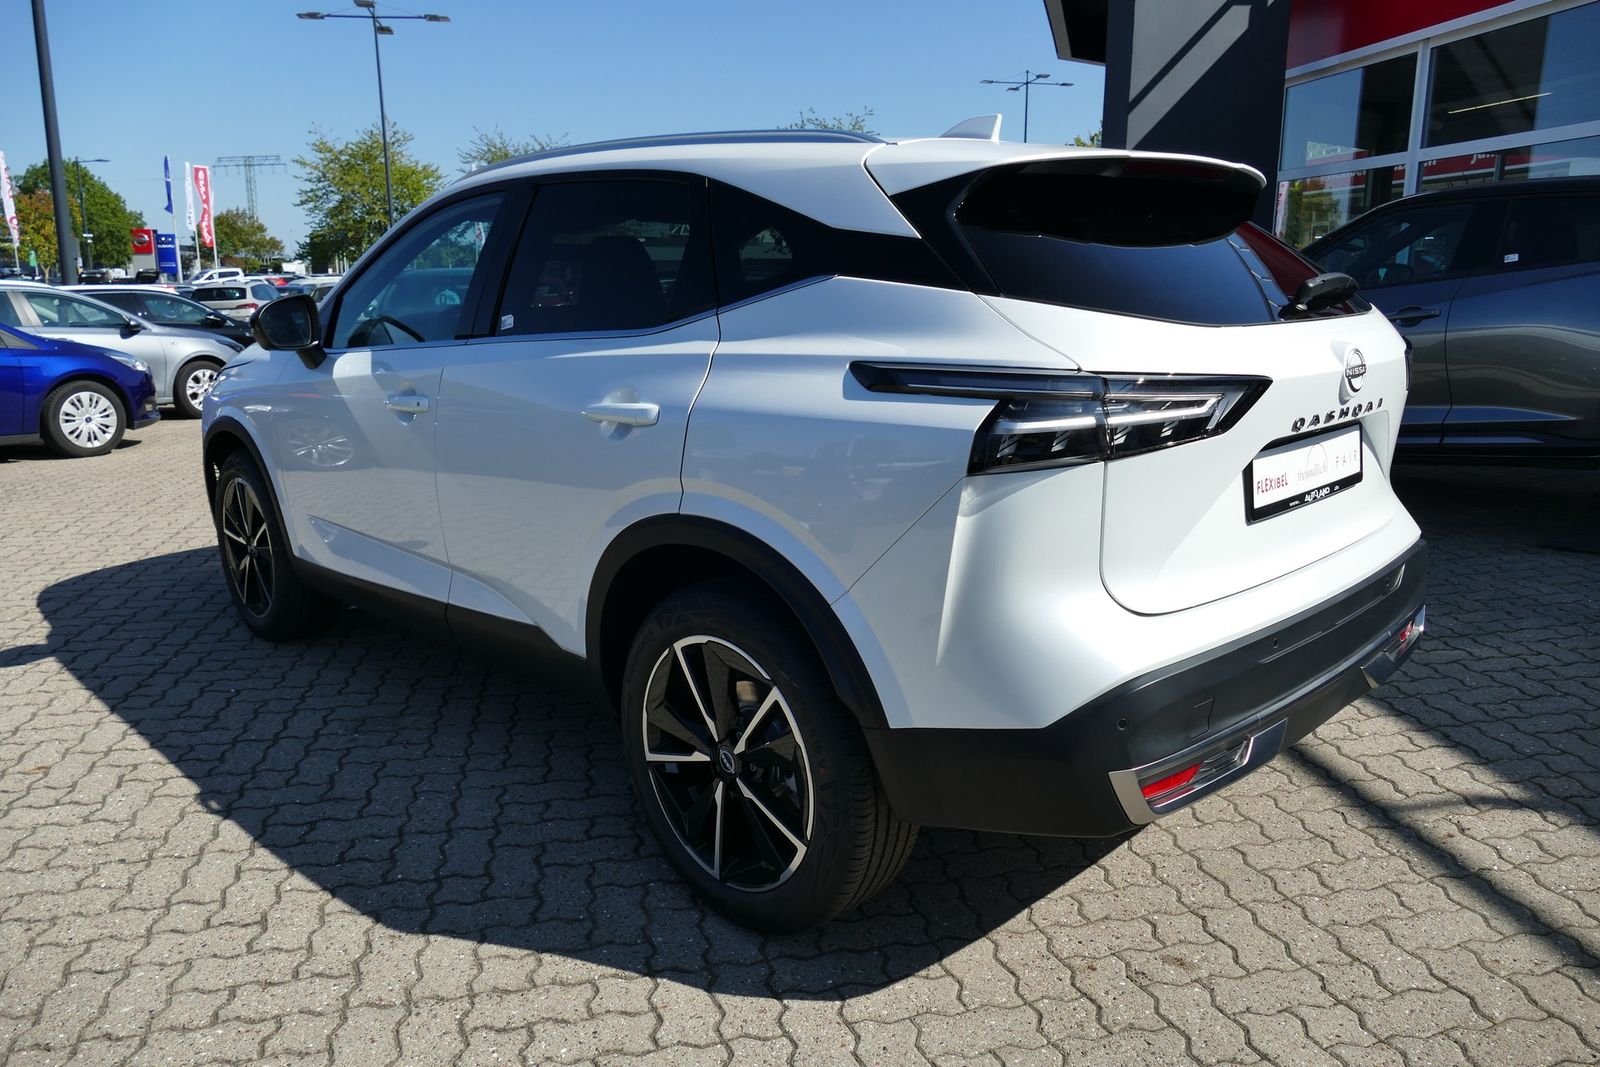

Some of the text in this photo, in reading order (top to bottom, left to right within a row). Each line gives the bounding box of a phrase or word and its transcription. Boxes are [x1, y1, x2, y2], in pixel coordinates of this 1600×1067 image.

[1346, 366, 1366, 377] NISSA
[1291, 398, 1383, 432] QASHQAI
[1256, 472, 1289, 495] FLEXIBEL
[1335, 450, 1358, 468] FAIR
[1304, 487, 1330, 502] AUTOLAND
